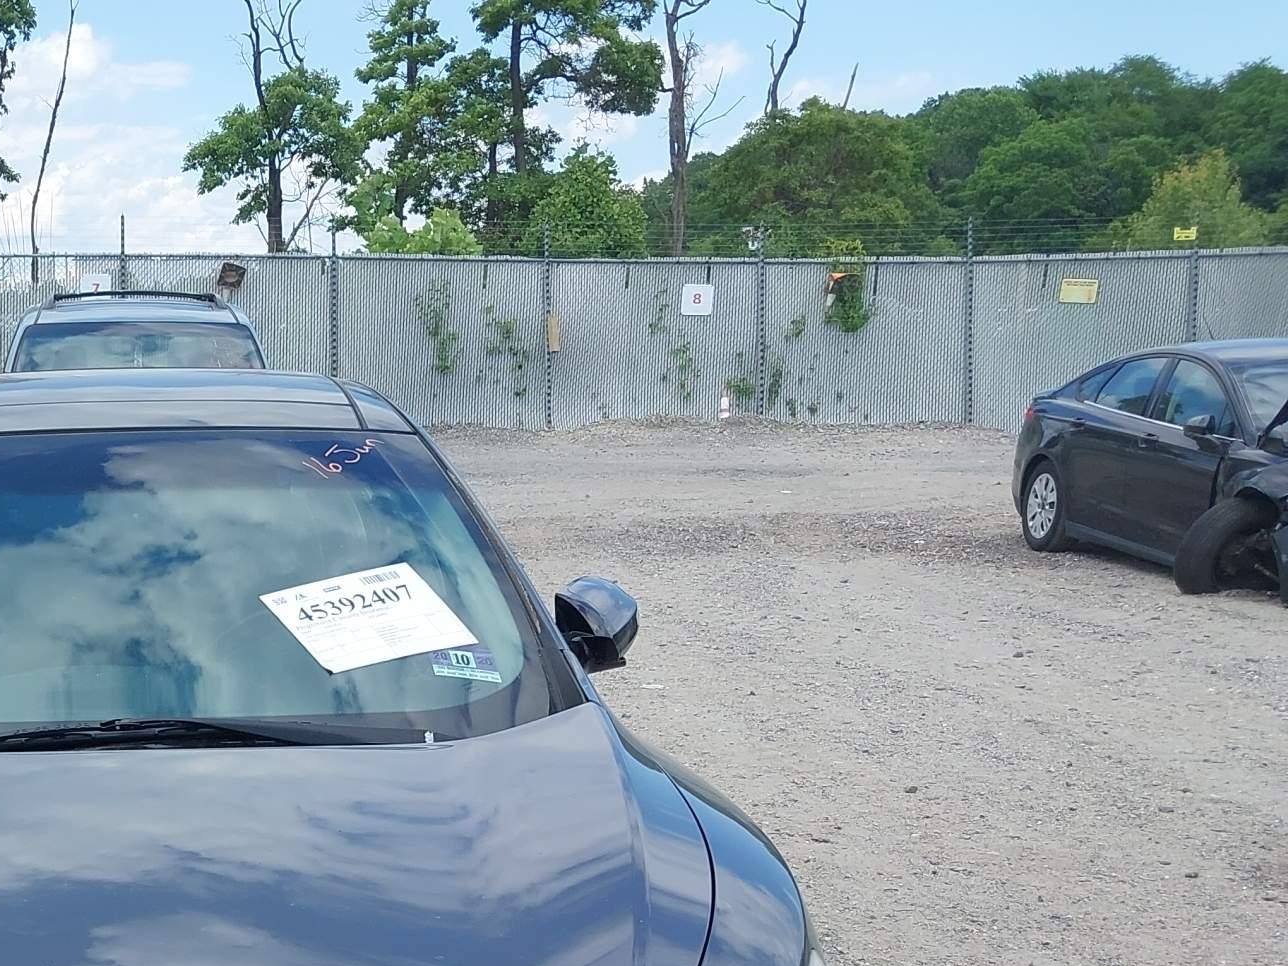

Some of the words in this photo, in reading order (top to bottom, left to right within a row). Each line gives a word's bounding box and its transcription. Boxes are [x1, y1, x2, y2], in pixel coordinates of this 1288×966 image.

[92, 283, 100, 294] 7
[692, 293, 702, 305] 8
[298, 584, 412, 621] 45392407
[452, 653, 471, 666] 10
